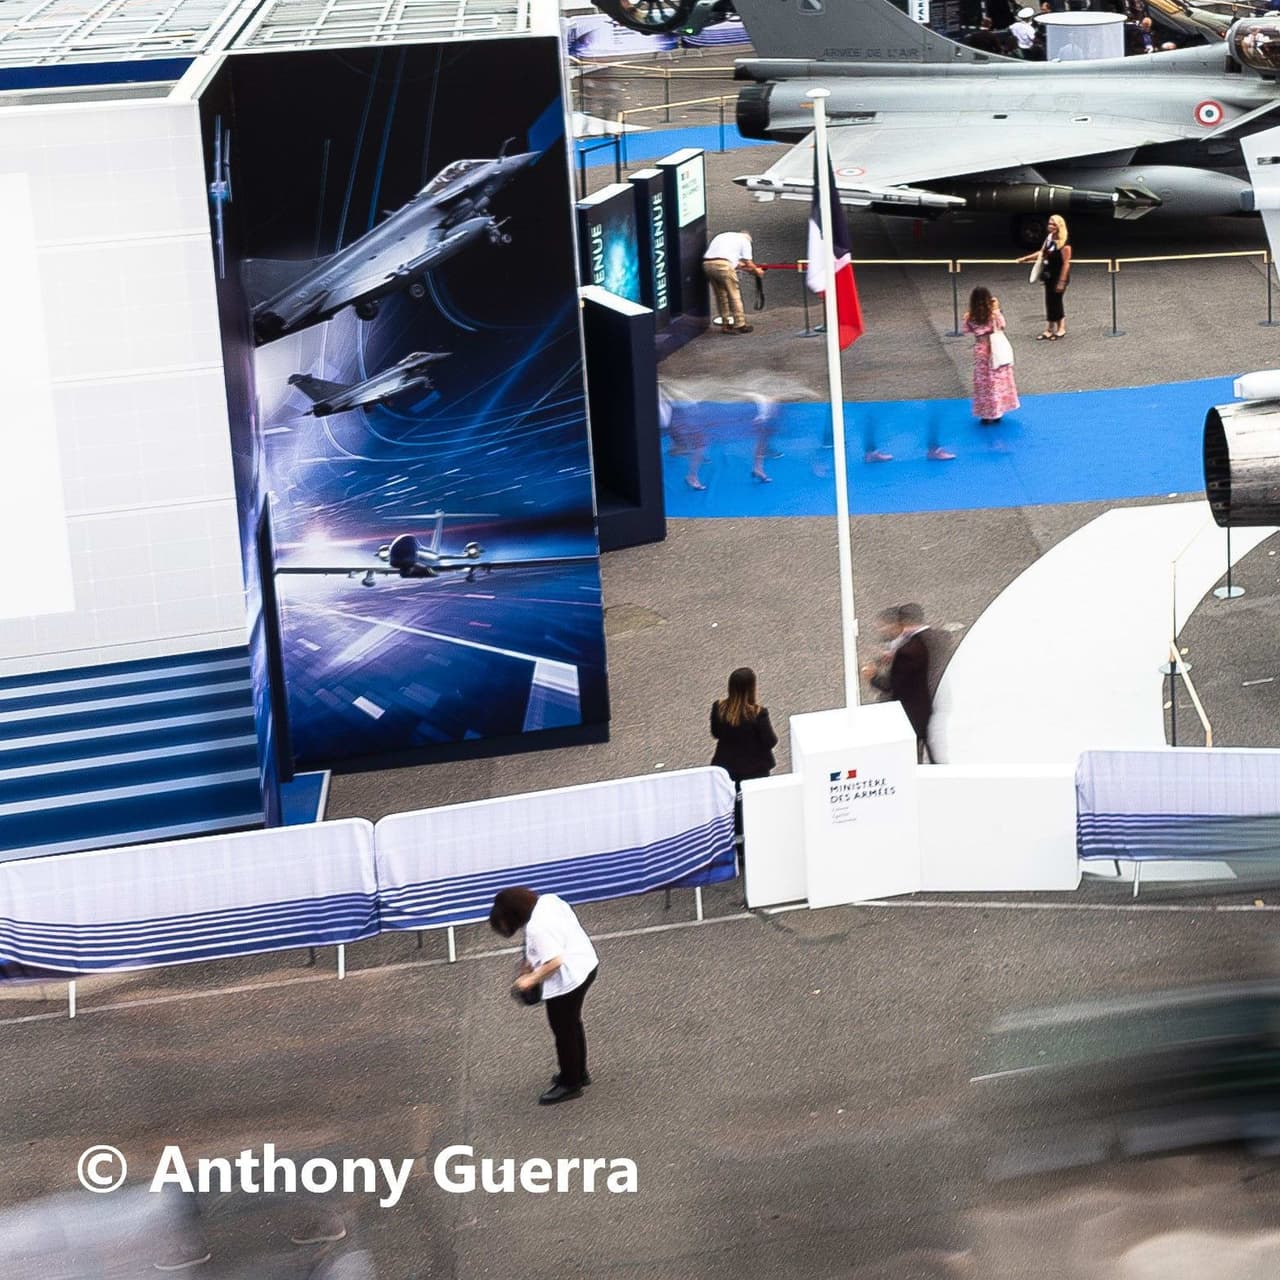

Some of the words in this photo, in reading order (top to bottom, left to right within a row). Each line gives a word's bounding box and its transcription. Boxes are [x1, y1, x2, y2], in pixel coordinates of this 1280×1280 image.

[592, 223, 605, 284] ENUE
[653, 191, 668, 310] BIENVENUE
[830, 793, 850, 804] DES
